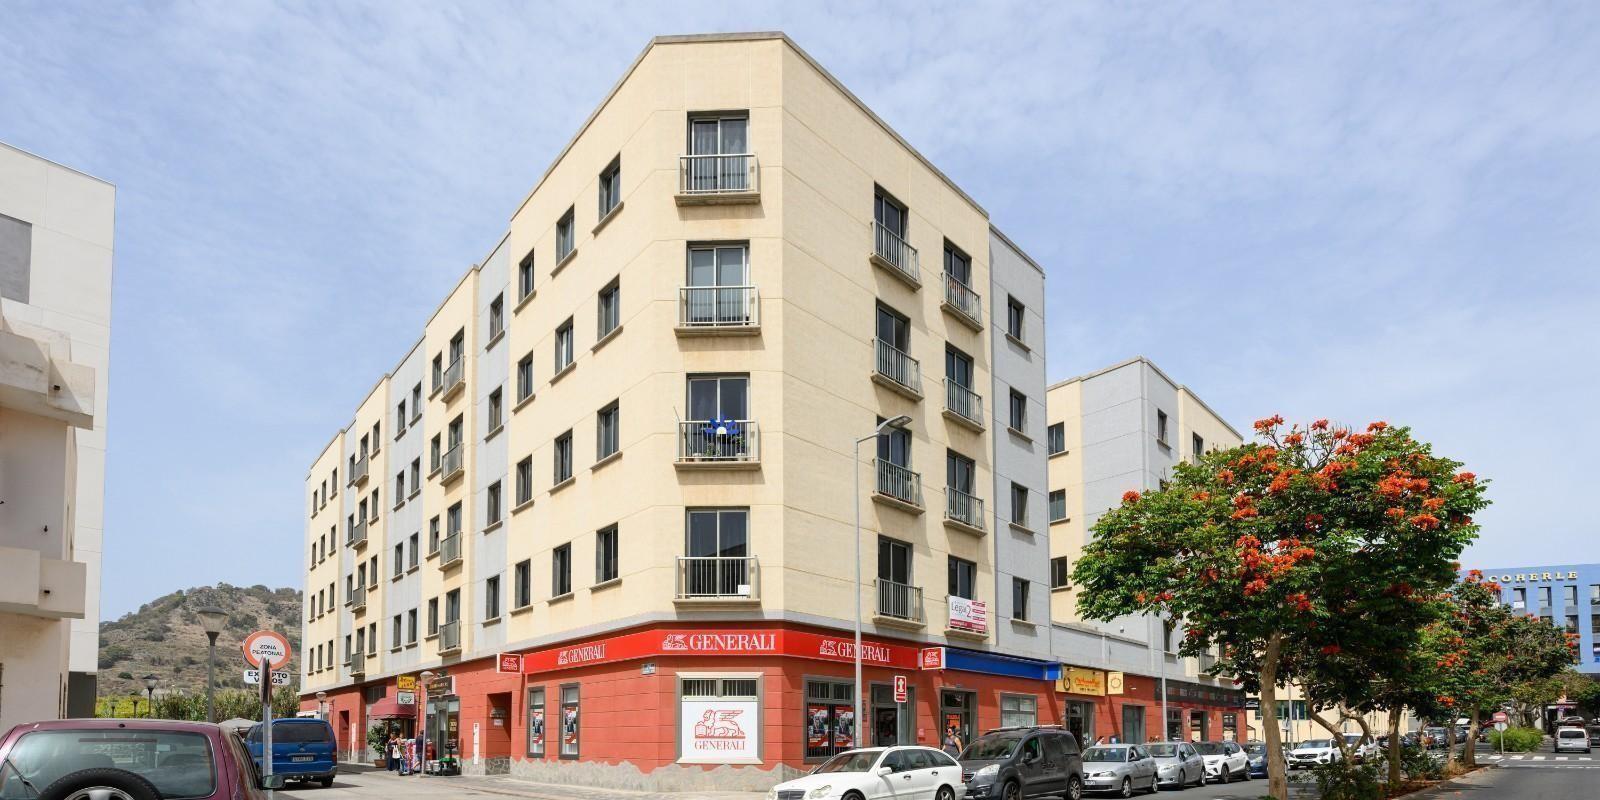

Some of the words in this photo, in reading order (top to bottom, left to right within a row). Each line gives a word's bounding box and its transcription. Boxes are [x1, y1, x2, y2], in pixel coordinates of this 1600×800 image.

[1488, 571, 1578, 583] COHERLE
[690, 634, 776, 651] GENERALI
[252, 649, 284, 657] PEATONAL
[568, 643, 606, 663] GENERALI
[247, 671, 288, 679] EXPTO
[253, 676, 283, 684] VOS
[694, 740, 745, 751] GENERALI
